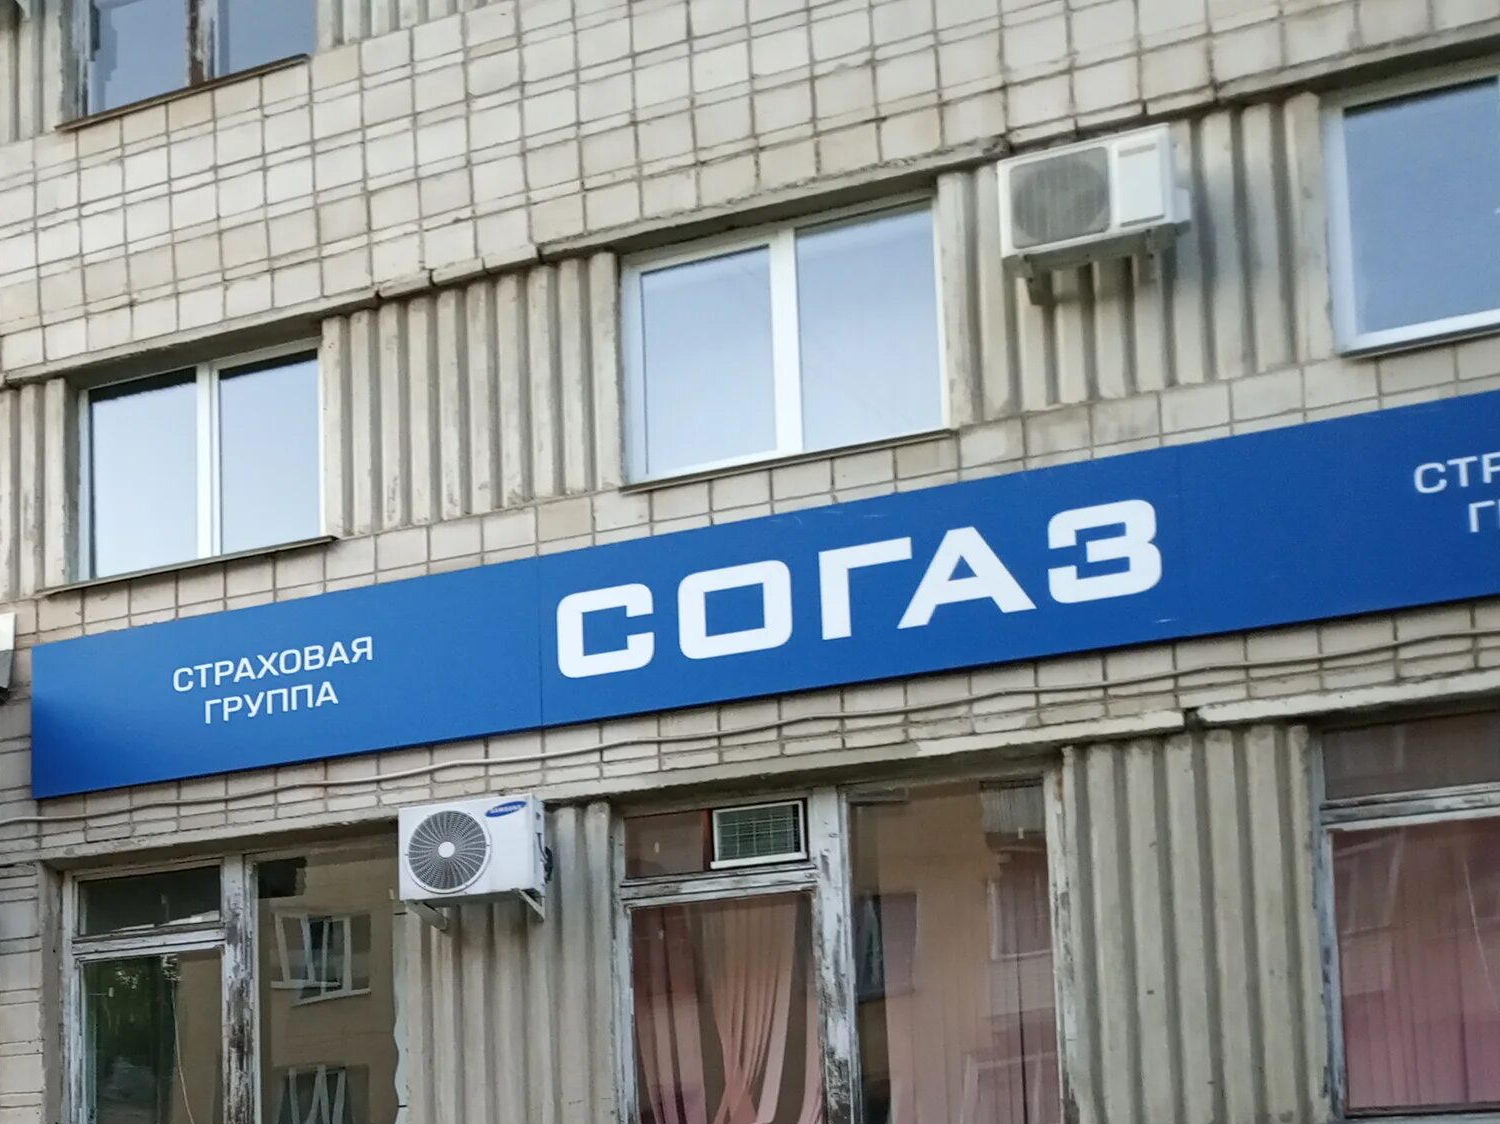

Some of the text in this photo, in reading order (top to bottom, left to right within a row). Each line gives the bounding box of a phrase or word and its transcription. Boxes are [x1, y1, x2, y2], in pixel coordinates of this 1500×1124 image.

[556, 498, 1163, 679] СОГАЗ
[172, 635, 374, 693] СТРАХОВАЯ
[204, 680, 340, 725] ГРУППА
